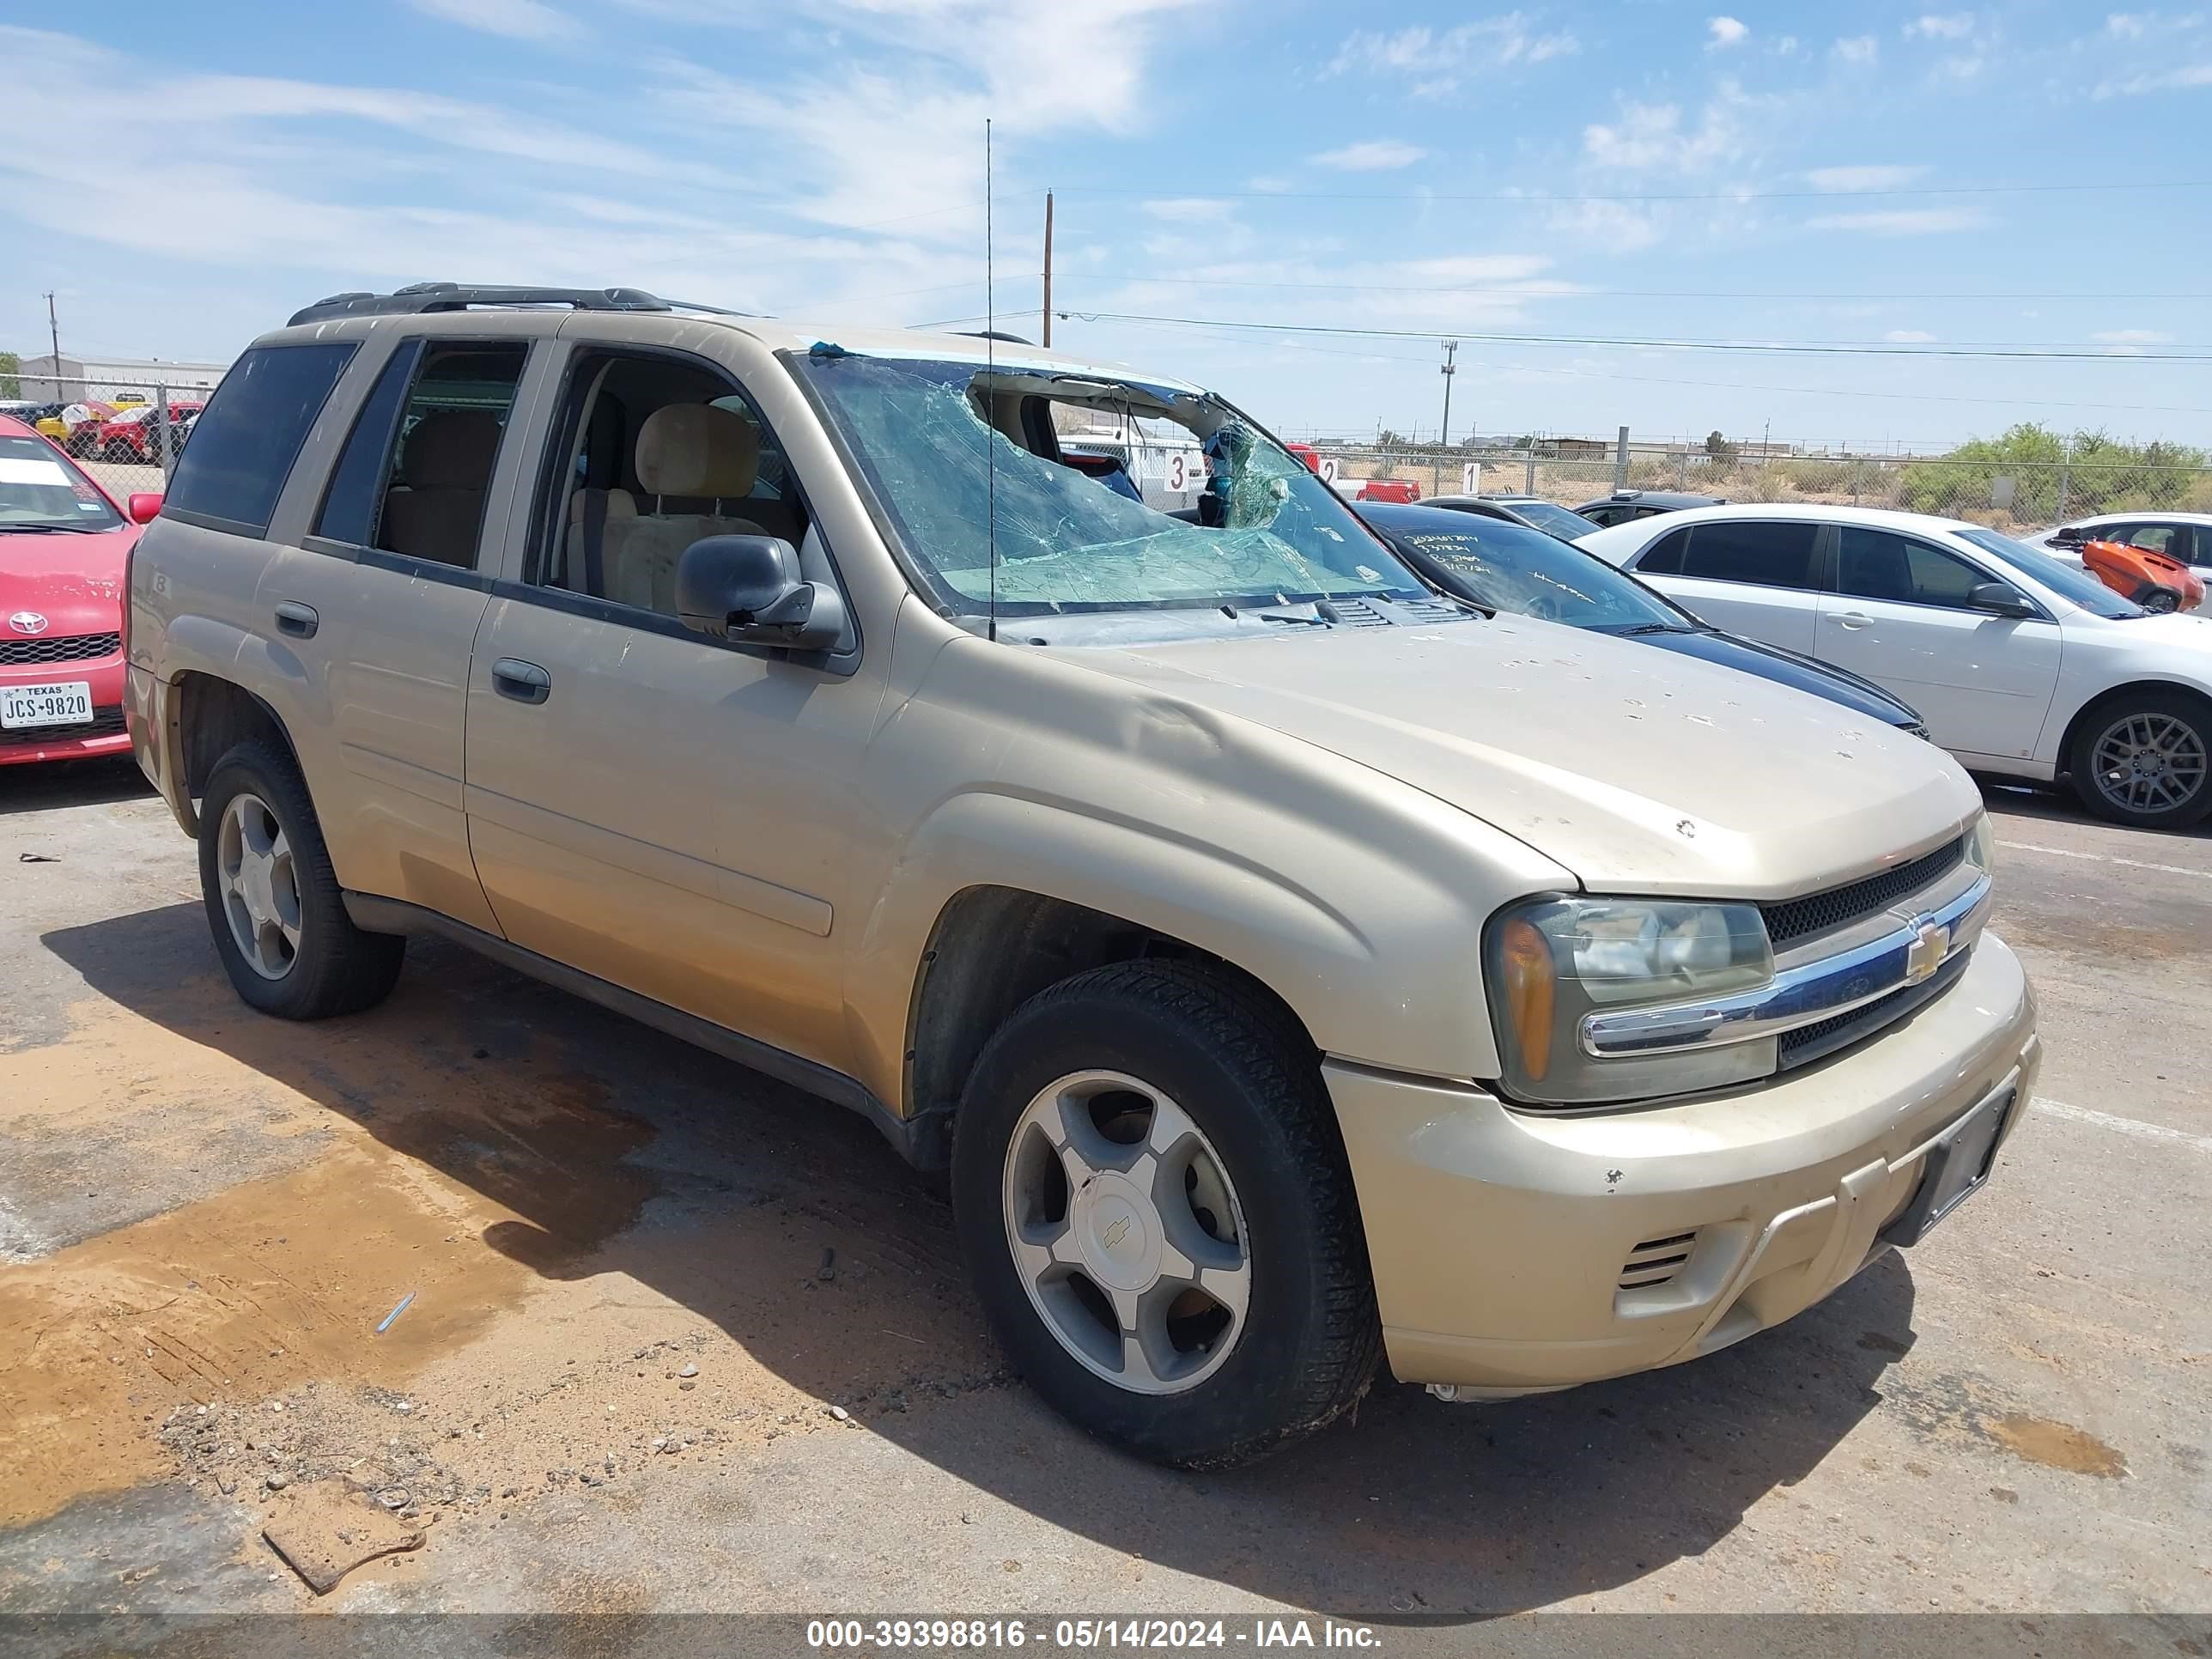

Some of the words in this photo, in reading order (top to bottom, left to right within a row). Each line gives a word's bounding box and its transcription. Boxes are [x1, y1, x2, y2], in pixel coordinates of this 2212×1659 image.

[1170, 456, 1184, 489] 3
[1325, 461, 1334, 483] 2
[1468, 465, 1474, 492] 1
[27, 686, 62, 696] TEXAS
